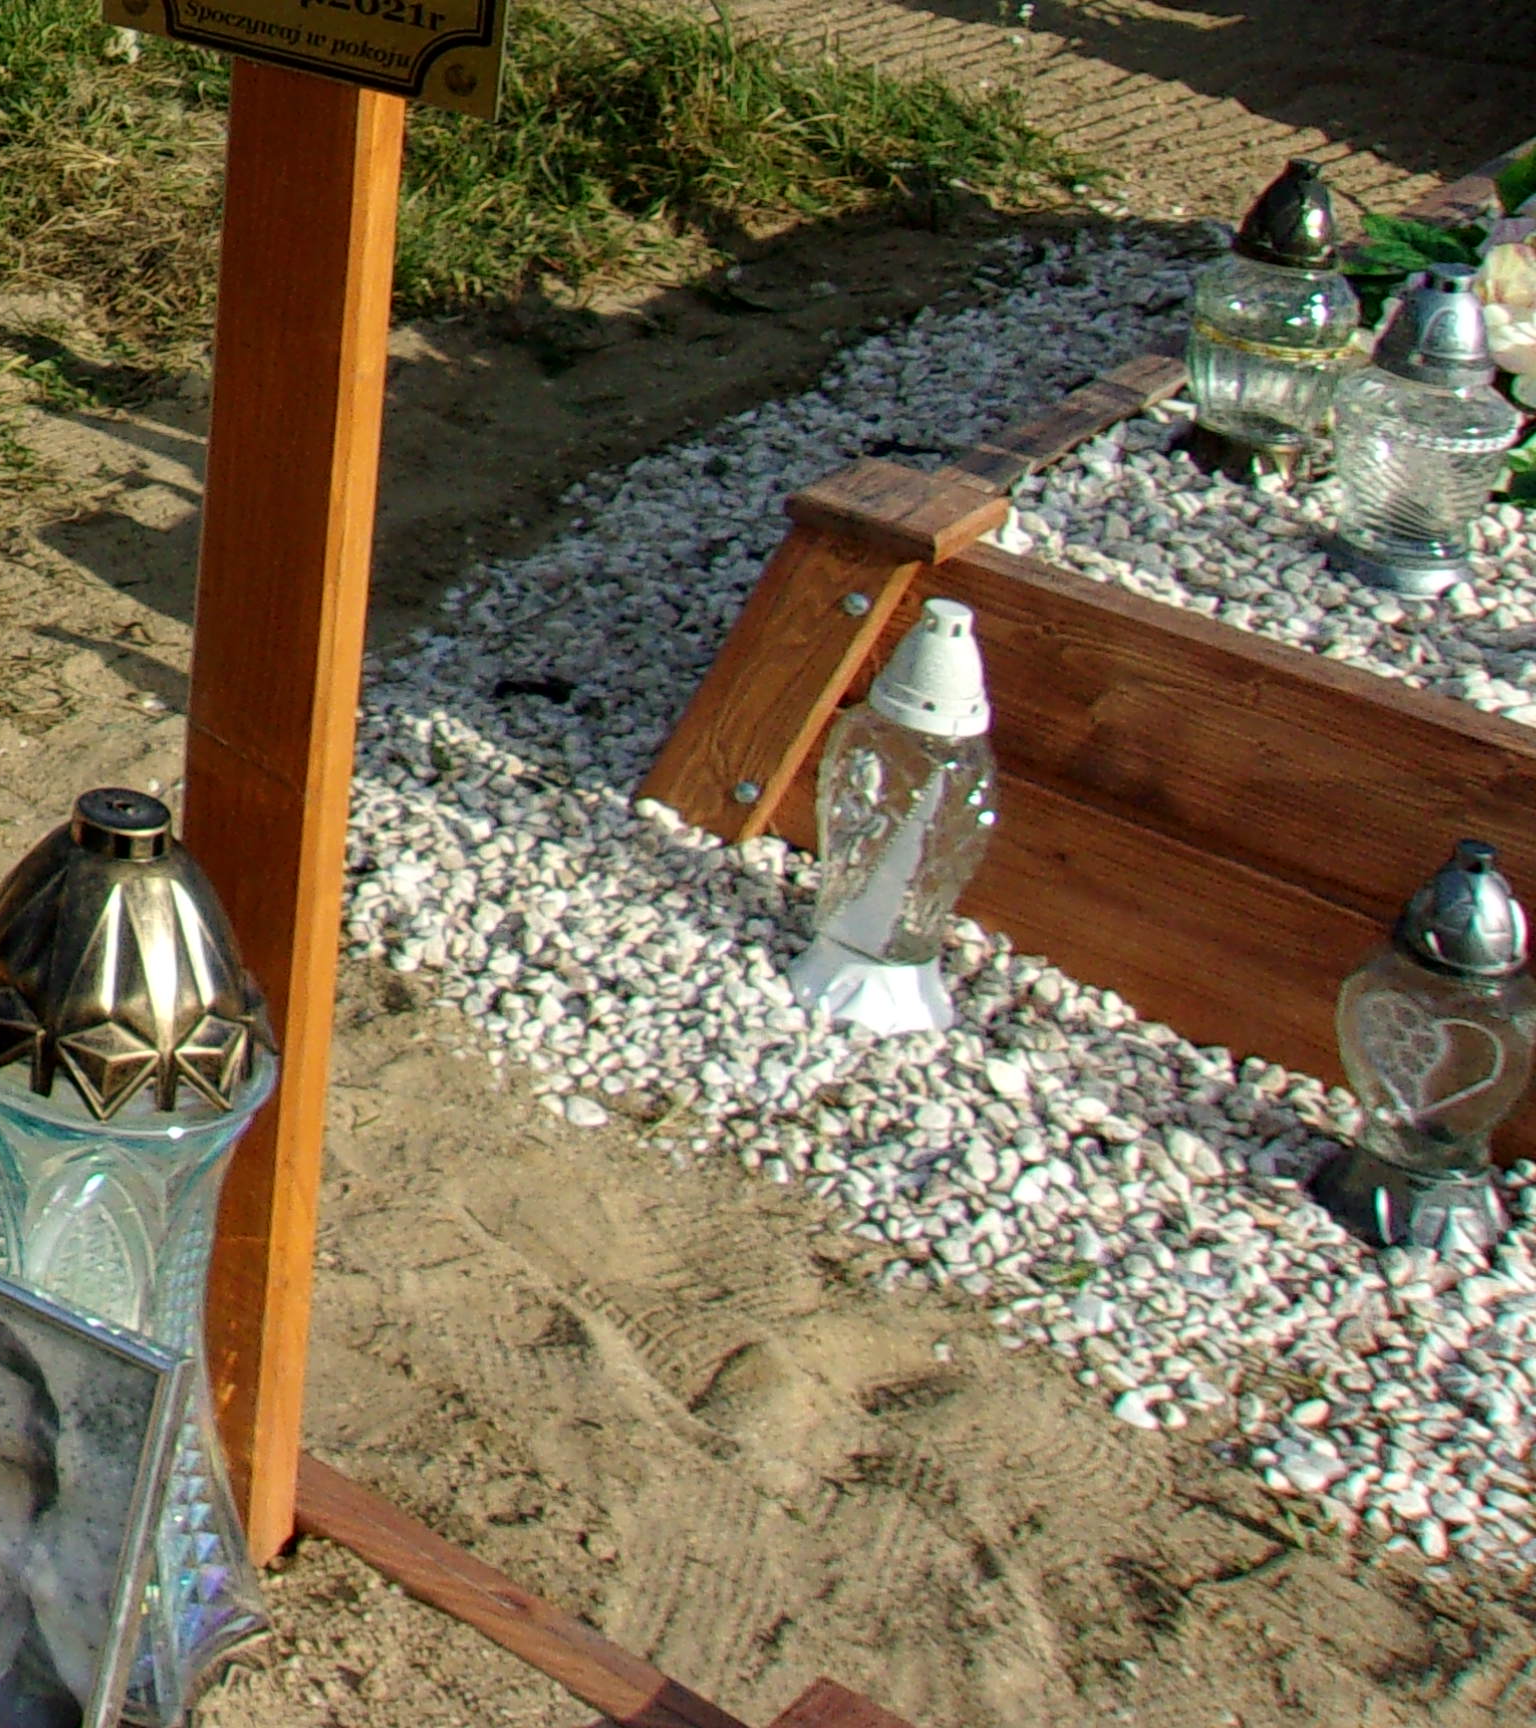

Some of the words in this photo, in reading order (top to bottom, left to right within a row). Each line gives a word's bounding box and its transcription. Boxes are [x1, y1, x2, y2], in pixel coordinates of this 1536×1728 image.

[184, 0, 303, 45] Spoczywaj
[307, 31, 327, 48] w
[330, 37, 411, 70] pokoju
